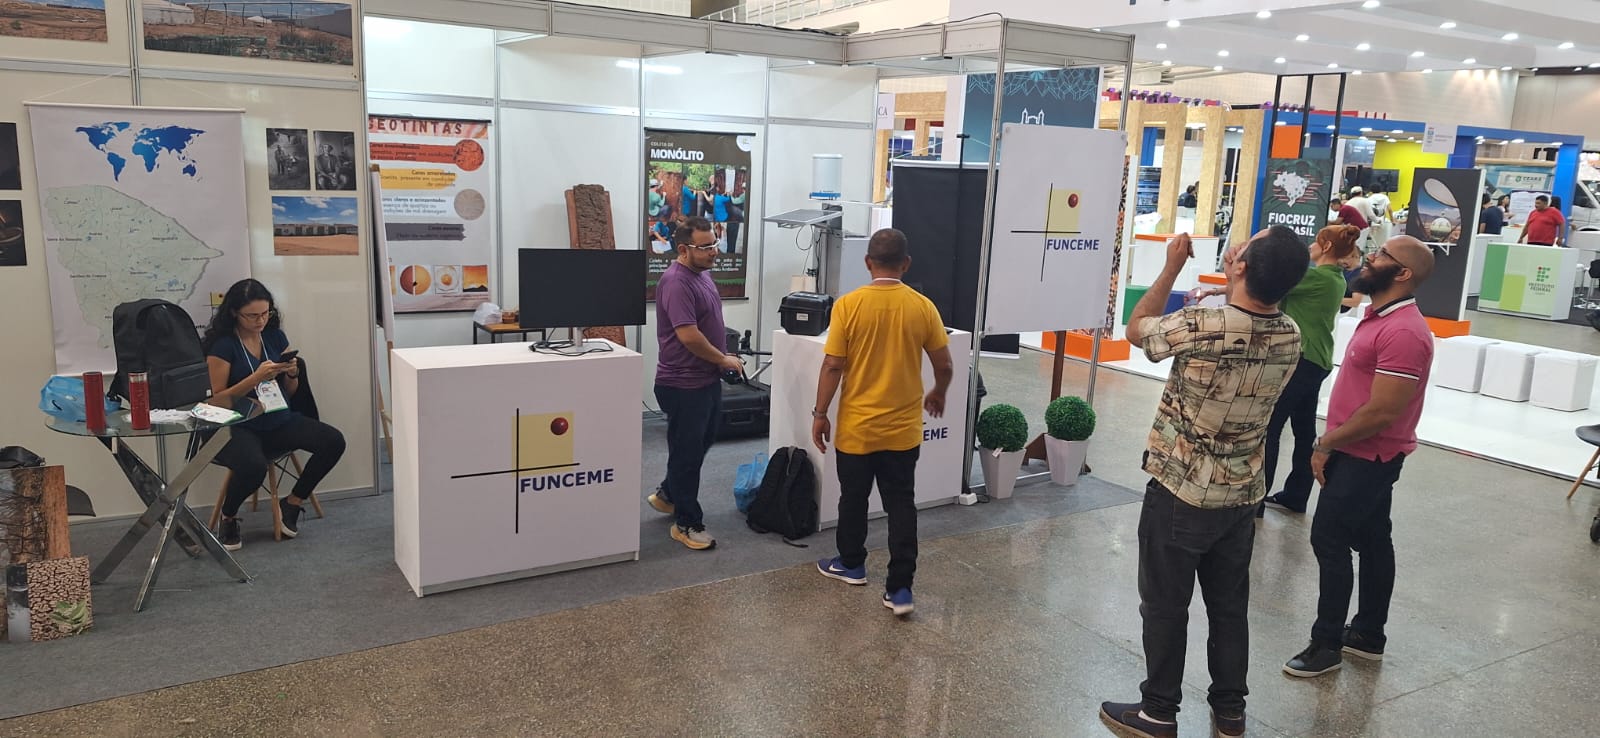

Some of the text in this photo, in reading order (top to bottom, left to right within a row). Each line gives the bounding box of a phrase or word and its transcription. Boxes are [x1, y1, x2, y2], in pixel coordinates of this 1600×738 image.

[650, 147, 705, 161] MONÓLITO
[1268, 212, 1316, 226] FIOCRUZ
[1287, 226, 1315, 237] ASIL
[1046, 239, 1100, 251] FUNCEME
[520, 468, 614, 493] FUNCEME
